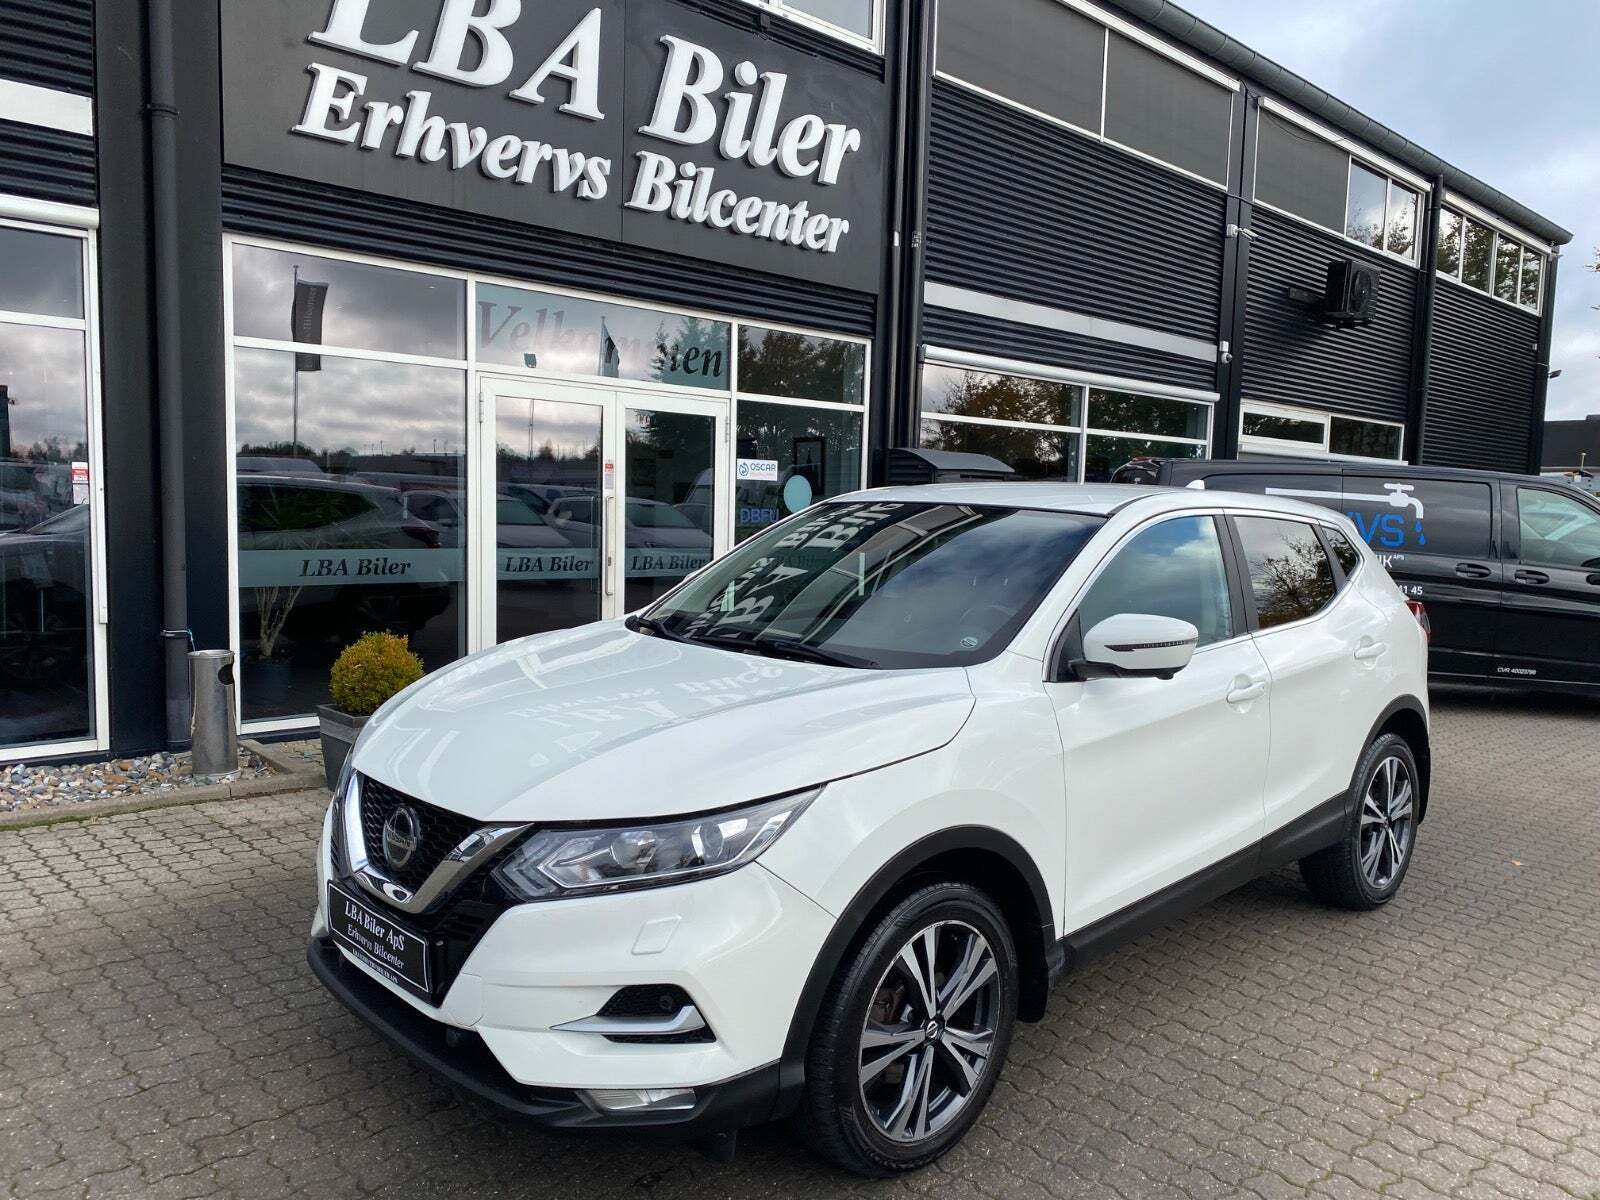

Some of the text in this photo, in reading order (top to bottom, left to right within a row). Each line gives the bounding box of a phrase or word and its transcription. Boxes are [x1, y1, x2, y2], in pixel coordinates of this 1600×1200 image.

[308, 0, 861, 186] LBA Biler
[291, 62, 850, 253] Erhvervs Bilcenter
[300, 557, 411, 577] LBA Biler
[505, 555, 593, 573] LBA Biler
[631, 555, 707, 571] LBA Biler
[1410, 585, 1423, 595] 45
[345, 901, 405, 951] LBA Biler ApS
[374, 941, 404, 969] Bilcenter
